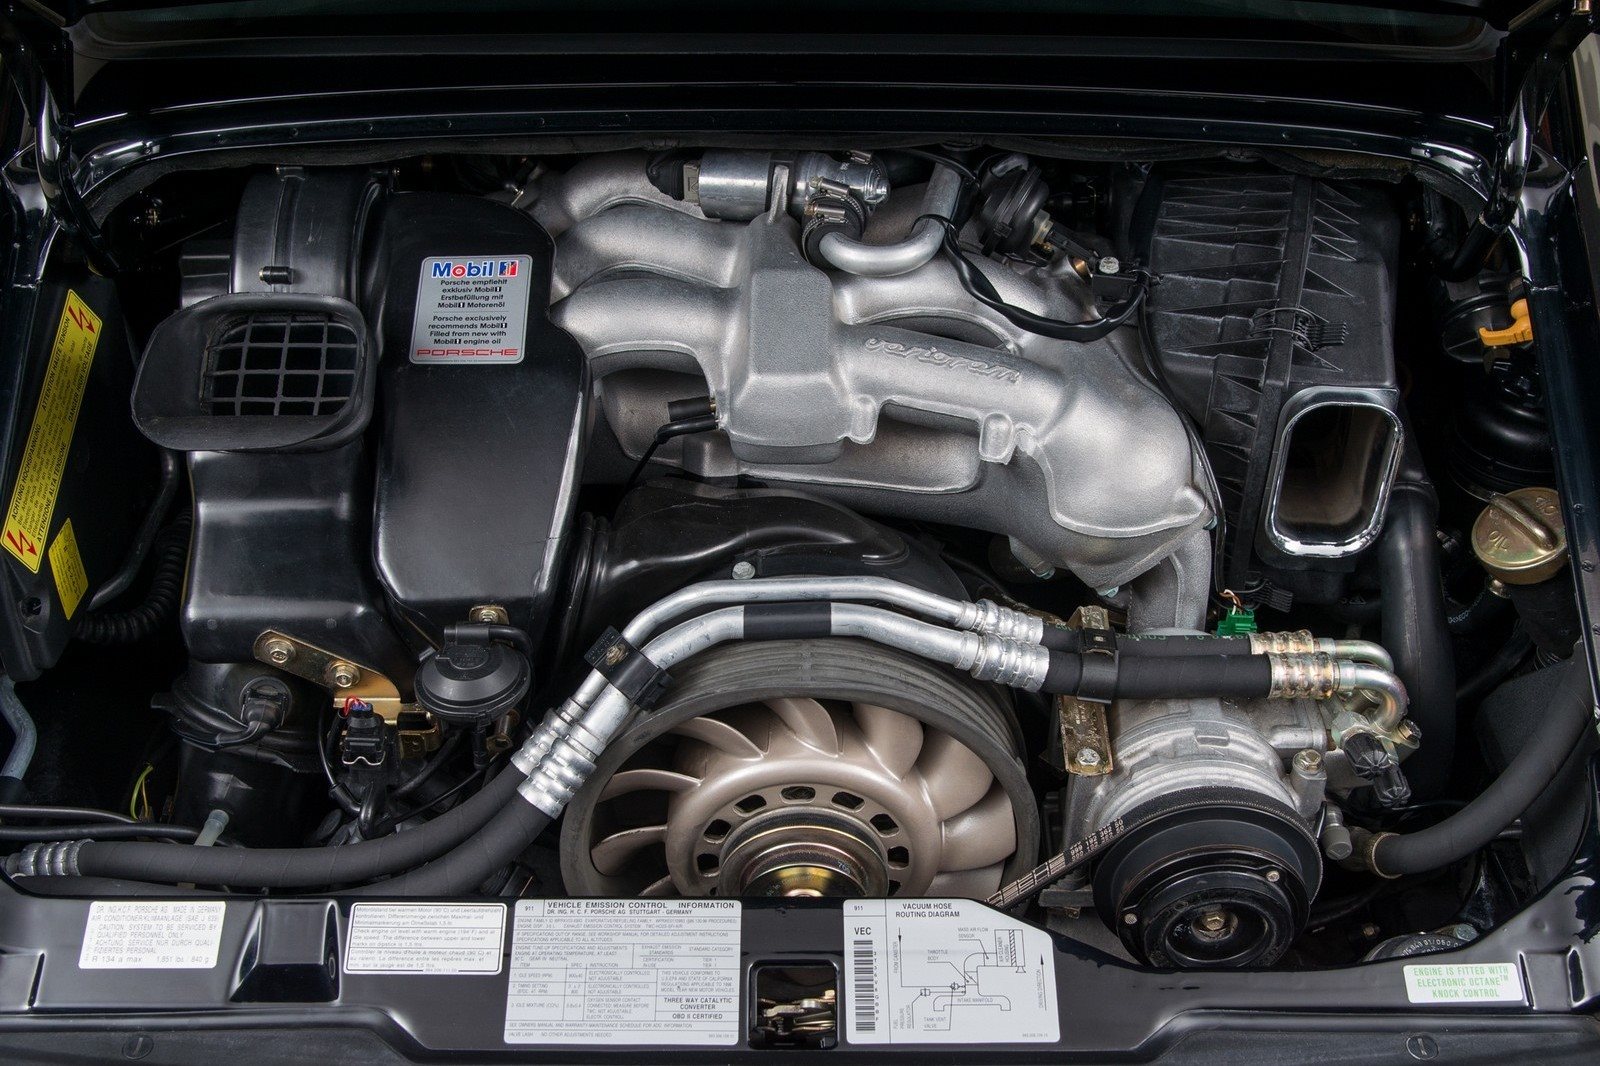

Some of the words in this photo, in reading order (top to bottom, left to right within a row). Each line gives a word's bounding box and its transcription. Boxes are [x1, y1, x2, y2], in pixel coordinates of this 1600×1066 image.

[432, 261, 494, 278] Mobil
[499, 261, 518, 276] 1
[11, 483, 25, 520] ACHTUNG
[21, 424, 41, 483] HOCHSPANNUNG
[41, 370, 55, 411] ATTENTION
[52, 347, 61, 371] HAUTE
[59, 316, 70, 345] TENSION
[36, 498, 51, 543] ATTENZIONE
[48, 478, 56, 497] ALTA
[53, 440, 66, 476] TENSIONE
[68, 392, 79, 423] DANGER
[81, 340, 92, 374] VOLTAGE
[22, 505, 31, 529] Electric
[26, 510, 36, 534] Danger
[1070, 844, 1082, 855] 999
[1114, 819, 1123, 828] 50
[854, 927, 871, 935] VEC
[1414, 967, 1442, 976] ENGINE
[1446, 967, 1454, 975] IS
[1458, 967, 1485, 975] FITTED
[1489, 966, 1508, 974] WITH
[1417, 978, 1466, 987] ELECTRONIC
[1432, 989, 1461, 998] KNOCK
[1464, 988, 1500, 998] CONTROL
